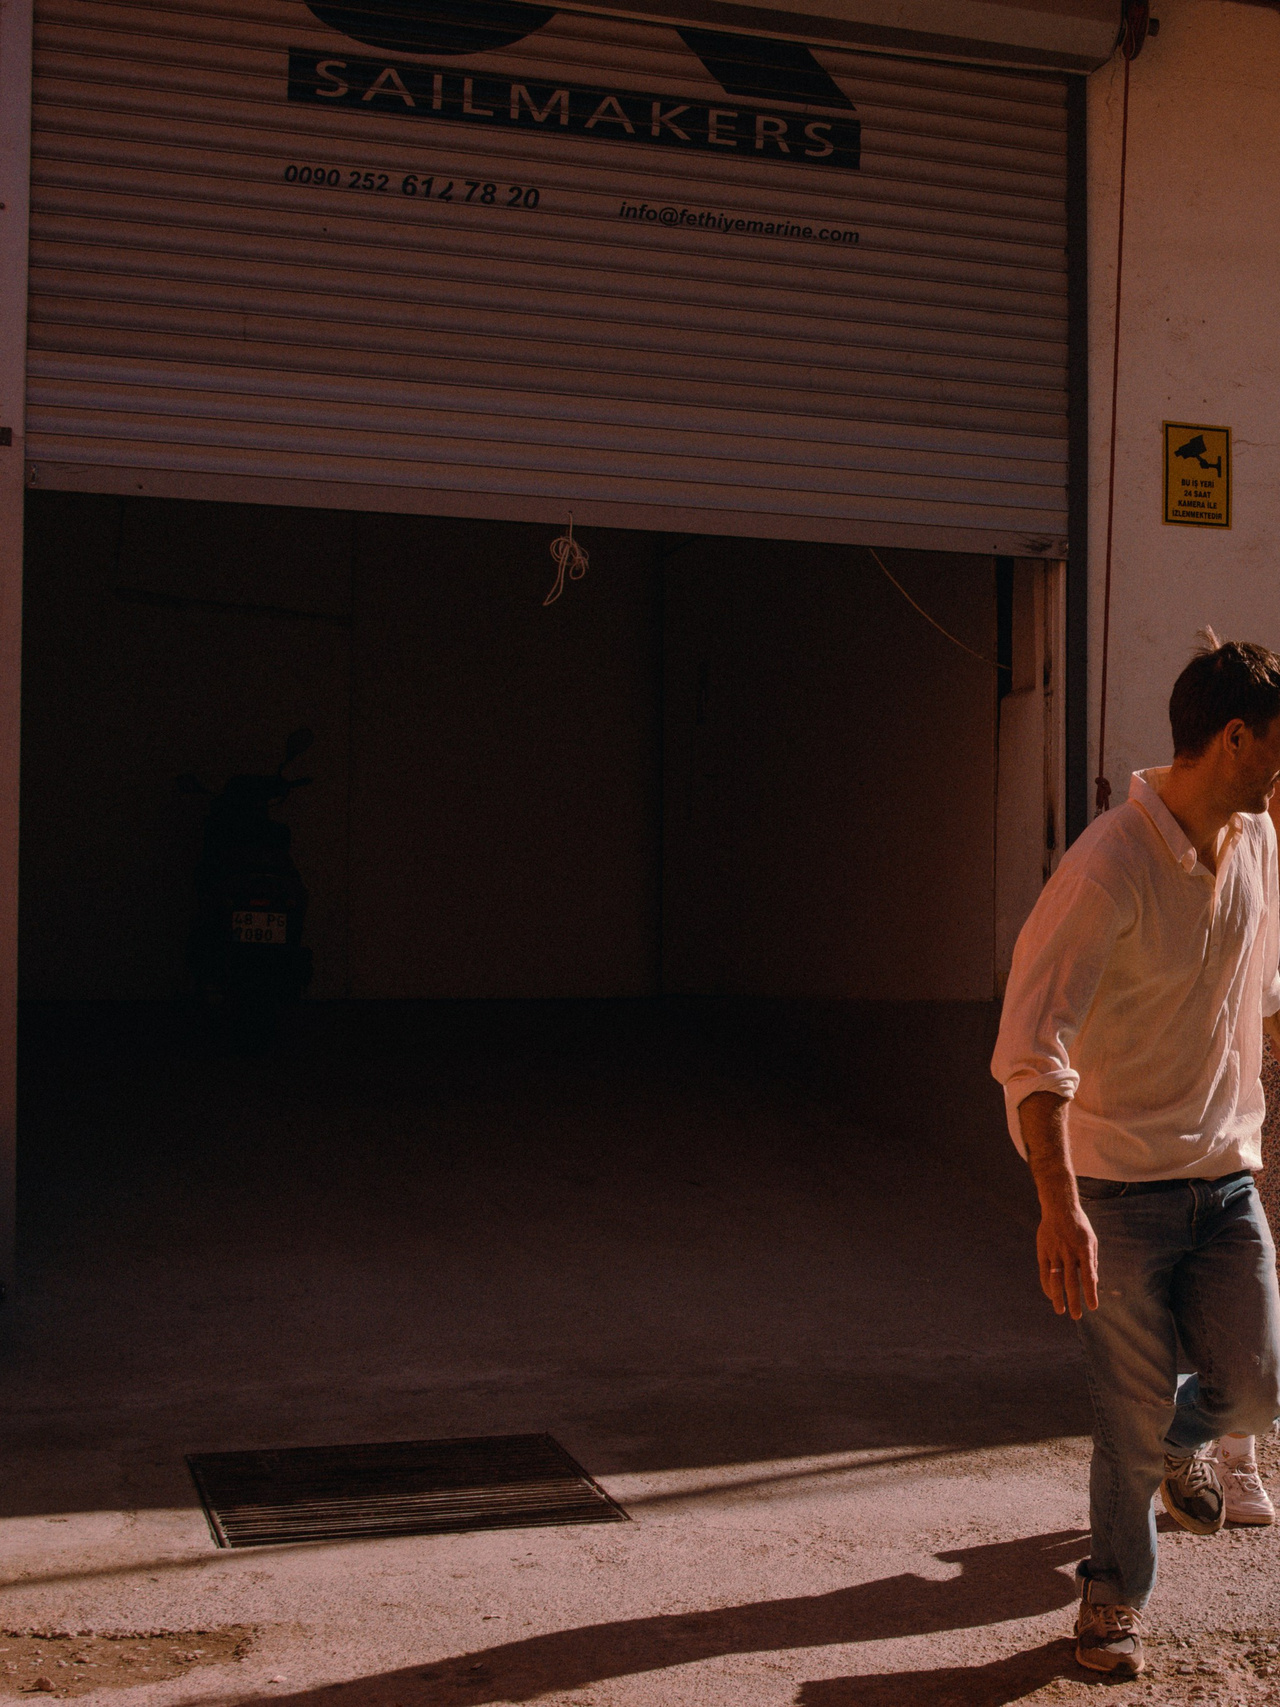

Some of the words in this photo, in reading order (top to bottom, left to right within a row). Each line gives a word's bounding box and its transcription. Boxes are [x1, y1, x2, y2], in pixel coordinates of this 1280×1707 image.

[313, 58, 837, 158] SAILMAKERS
[284, 165, 341, 187] 0090
[348, 171, 390, 192] 252
[464, 181, 498, 205] 78
[507, 186, 541, 210] 20
[619, 202, 860, 244] info@fethiyemarine.com
[1178, 500, 1205, 508] KAMERA
[1194, 490, 1211, 498] SAAT
